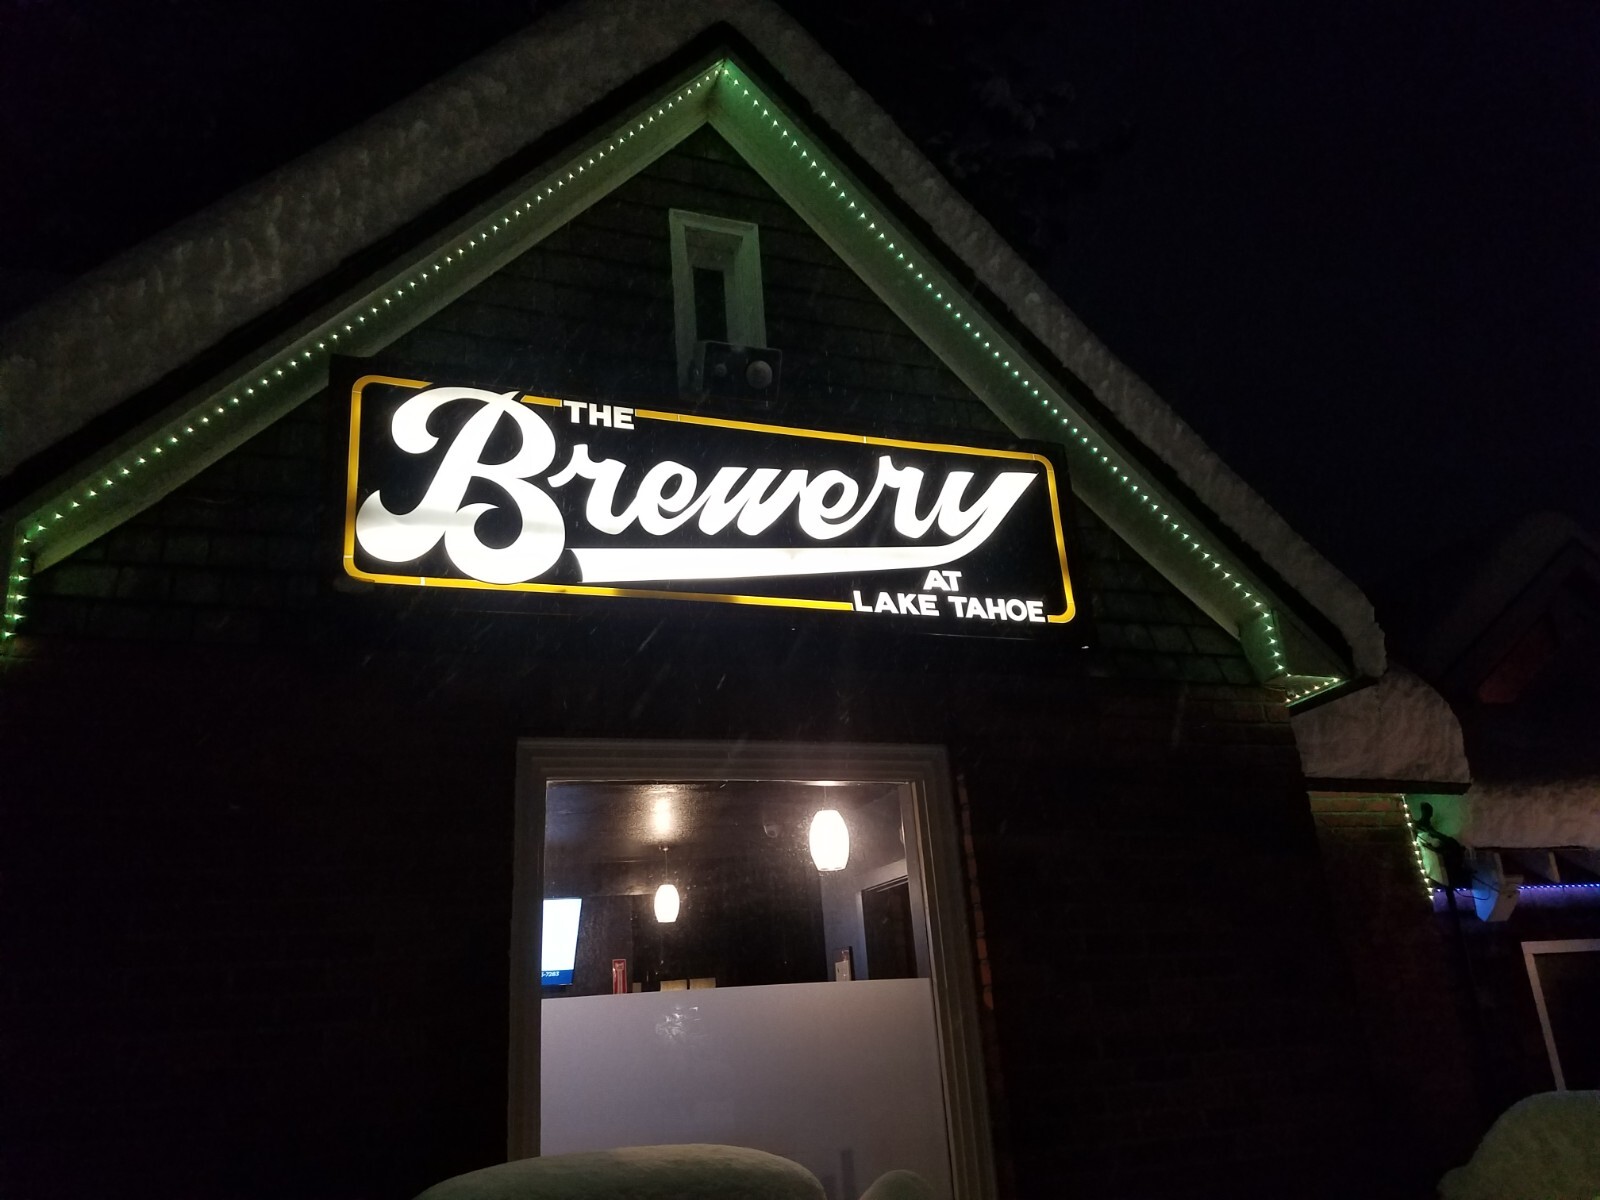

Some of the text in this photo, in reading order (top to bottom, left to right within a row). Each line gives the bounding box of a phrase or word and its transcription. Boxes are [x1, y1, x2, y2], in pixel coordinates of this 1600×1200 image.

[563, 399, 636, 431] THE
[356, 386, 1038, 585] Brewery
[922, 569, 963, 593] AT
[852, 589, 1046, 623] LAKE TAHOE
